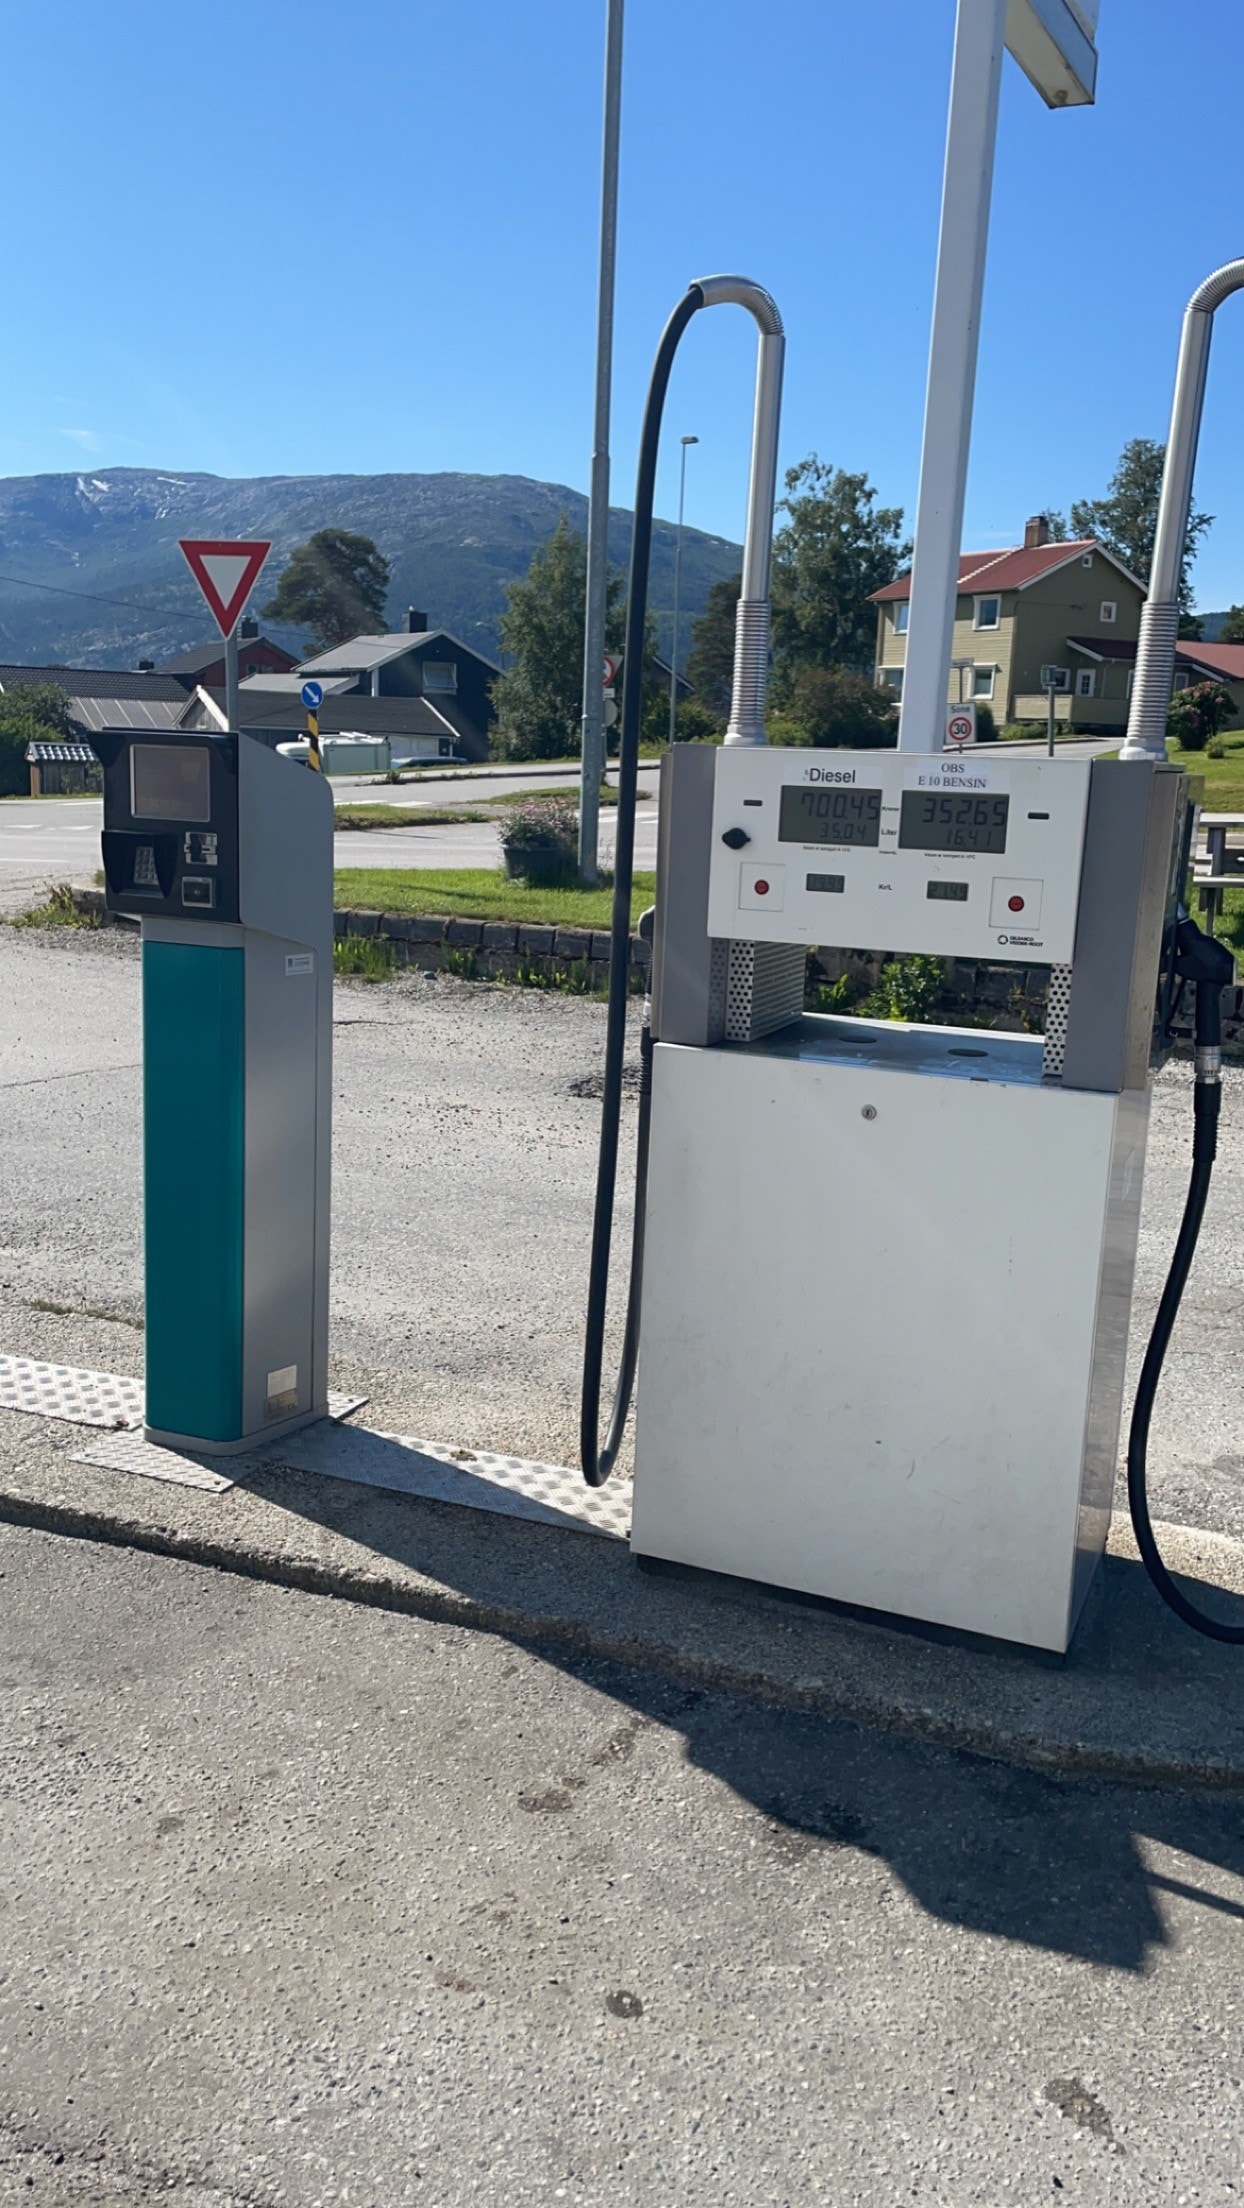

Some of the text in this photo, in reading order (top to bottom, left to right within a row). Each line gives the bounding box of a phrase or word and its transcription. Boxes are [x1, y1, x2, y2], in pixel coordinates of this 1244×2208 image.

[950, 705, 970, 713] Sone
[953, 723, 968, 735] 30
[941, 763, 965, 773] OBS
[809, 767, 856, 783] Diesel
[918, 776, 987, 788] E 10 BENSIN
